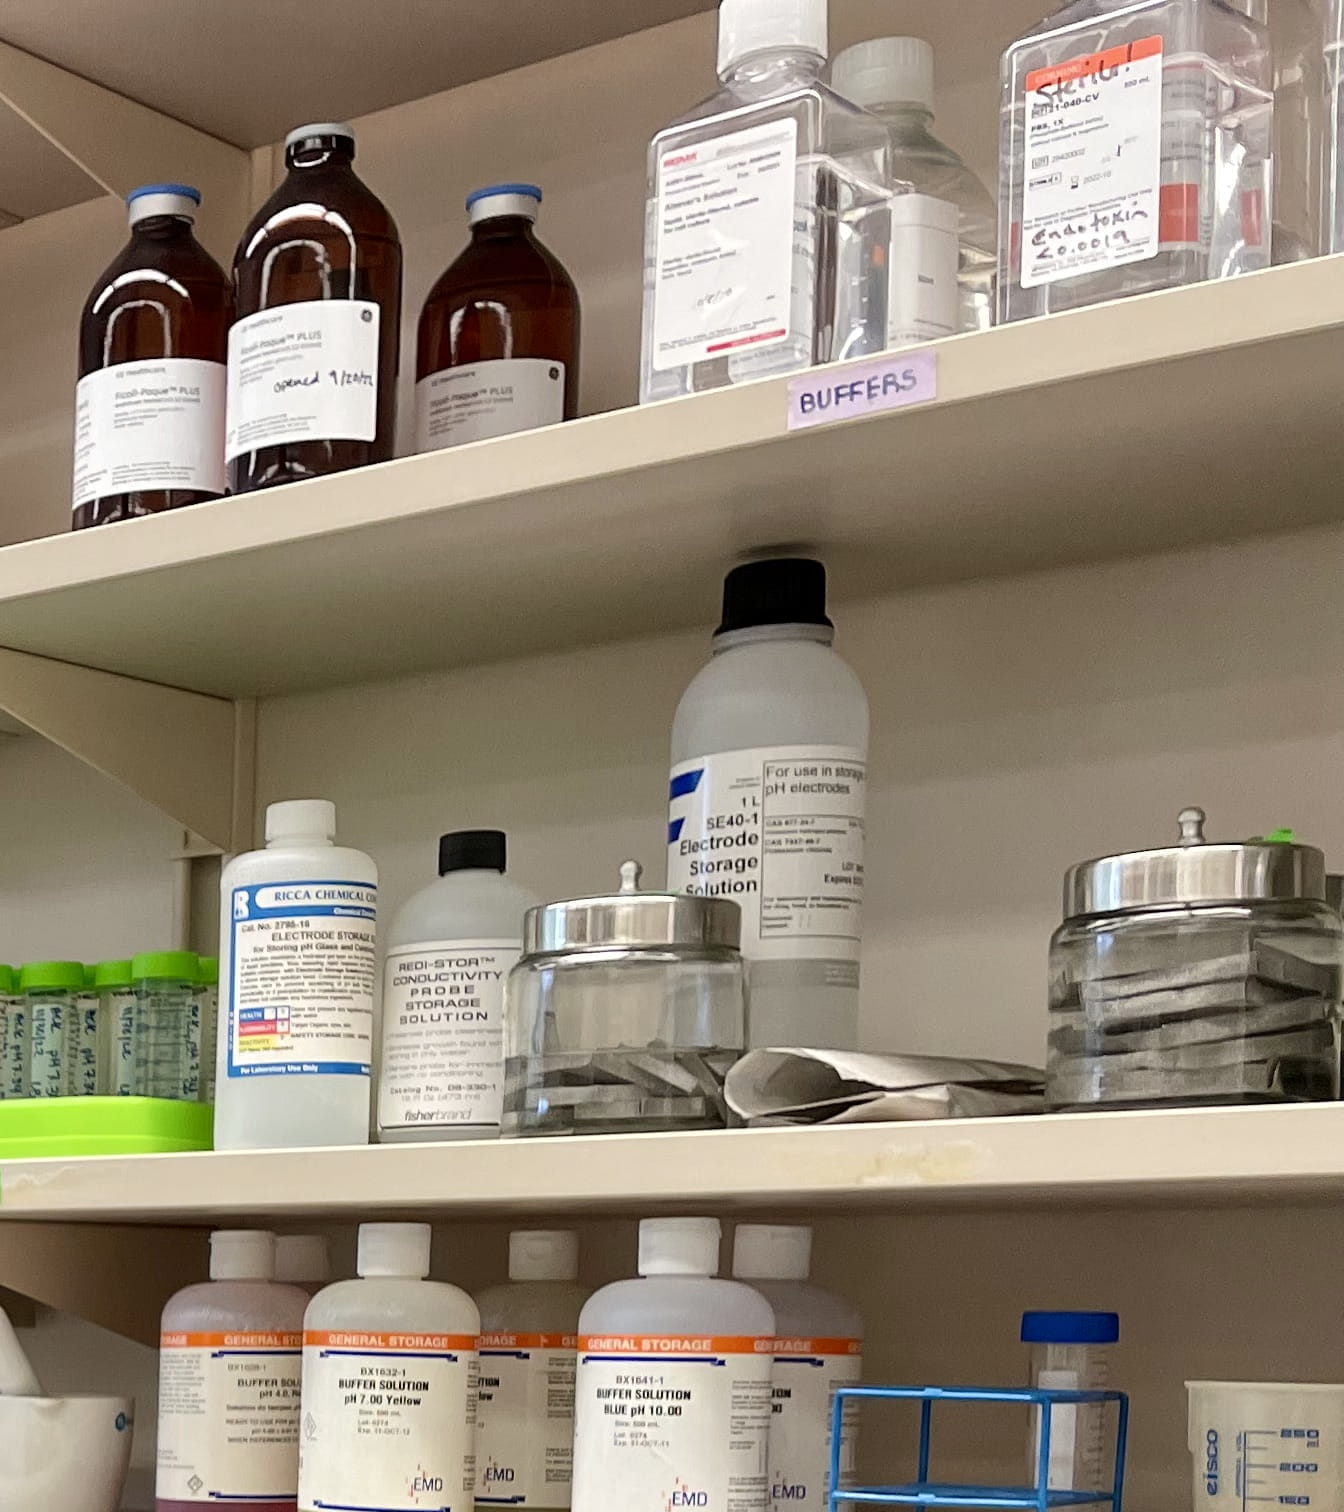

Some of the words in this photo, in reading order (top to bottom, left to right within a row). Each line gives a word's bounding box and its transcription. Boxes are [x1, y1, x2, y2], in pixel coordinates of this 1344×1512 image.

[799, 369, 917, 414] BUFFERS
[766, 766, 790, 779] For
[794, 766, 817, 778] use
[822, 766, 832, 777] in
[765, 783, 786, 797] pH
[790, 783, 851, 795] electrodes
[706, 812, 759, 831] SE40-1
[680, 831, 759, 856] Electrode
[690, 856, 759, 877] Storage
[686, 879, 758, 897] Solution
[274, 890, 311, 901] RICCA
[315, 889, 364, 901] CHEMICAL
[271, 931, 334, 942] ELECTRODE
[393, 971, 503, 986] CONDUCTIVITY
[410, 984, 475, 997] PROBE
[405, 997, 481, 1011] STORAGE
[400, 1011, 488, 1025] SOLUTION
[287, 1065, 302, 1073] Use
[303, 1064, 318, 1073] Only
[405, 1108, 472, 1121] fisherbrand
[224, 1335, 281, 1346] GENERAL
[329, 1334, 385, 1346] GENERAL
[389, 1335, 449, 1347] STORAGE
[588, 1339, 638, 1351] GENERAL
[641, 1340, 712, 1351] STORAGE
[237, 1378, 279, 1387] BUFFER
[339, 1379, 376, 1390] BUFFER
[379, 1380, 430, 1391] SOLUTION
[259, 1390, 272, 1399] pH
[344, 1394, 357, 1406] pH
[361, 1394, 383, 1405] 7.00
[386, 1395, 422, 1406] Yellow
[596, 1388, 632, 1399] BUFFER
[635, 1389, 691, 1400] SOLUTION
[604, 1404, 628, 1416] BLUE
[630, 1405, 645, 1417] pH
[649, 1405, 682, 1416] 10.00
[1280, 1429, 1319, 1438] 250
[1203, 1429, 1218, 1496] eisco
[1280, 1463, 1318, 1472] 200
[486, 1467, 515, 1481] EMD
[413, 1477, 443, 1491] EMD
[672, 1491, 707, 1506] EMD
[772, 1485, 806, 1499] EMD
